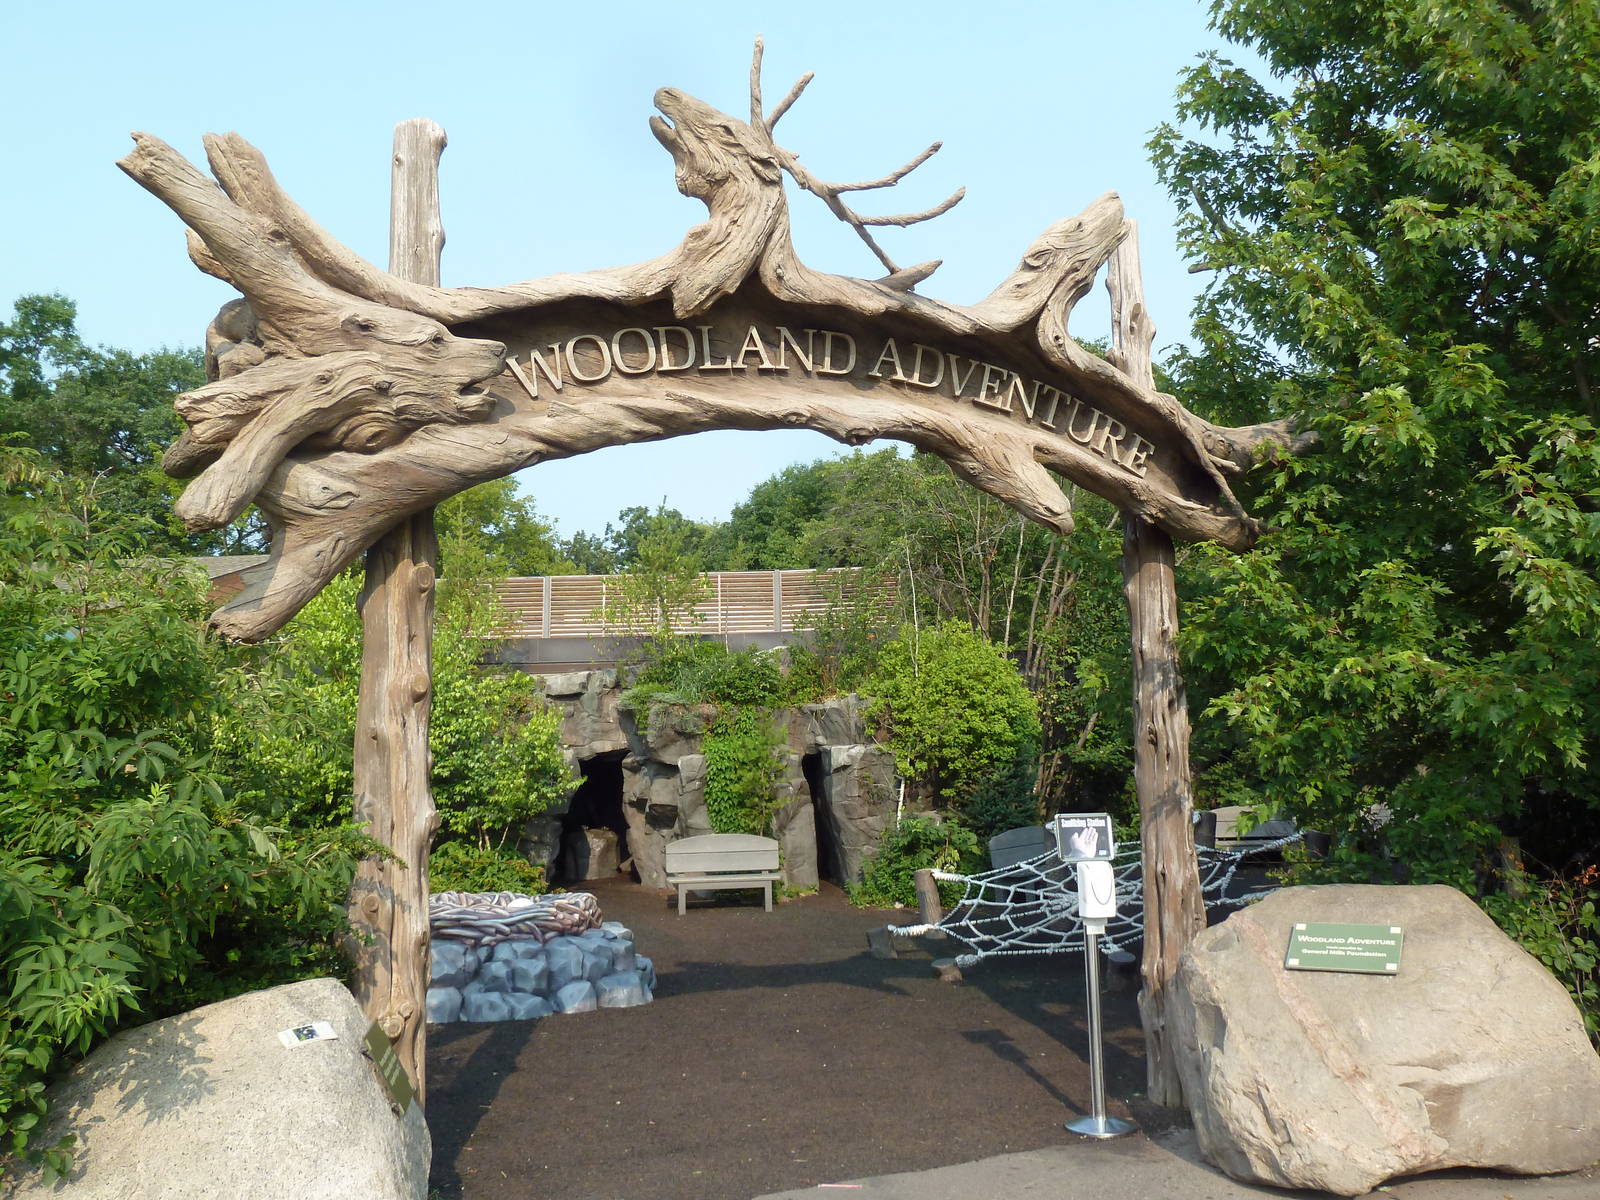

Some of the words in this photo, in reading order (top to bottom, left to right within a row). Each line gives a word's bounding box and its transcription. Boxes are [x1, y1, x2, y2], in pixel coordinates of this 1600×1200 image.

[505, 325, 857, 399] WOODLAND
[868, 337, 1155, 479] ADVENTURE
[1297, 935, 1345, 944] WOODLAND
[1347, 937, 1396, 946] ADVENTURE
[1346, 950, 1387, 958] Foundation
